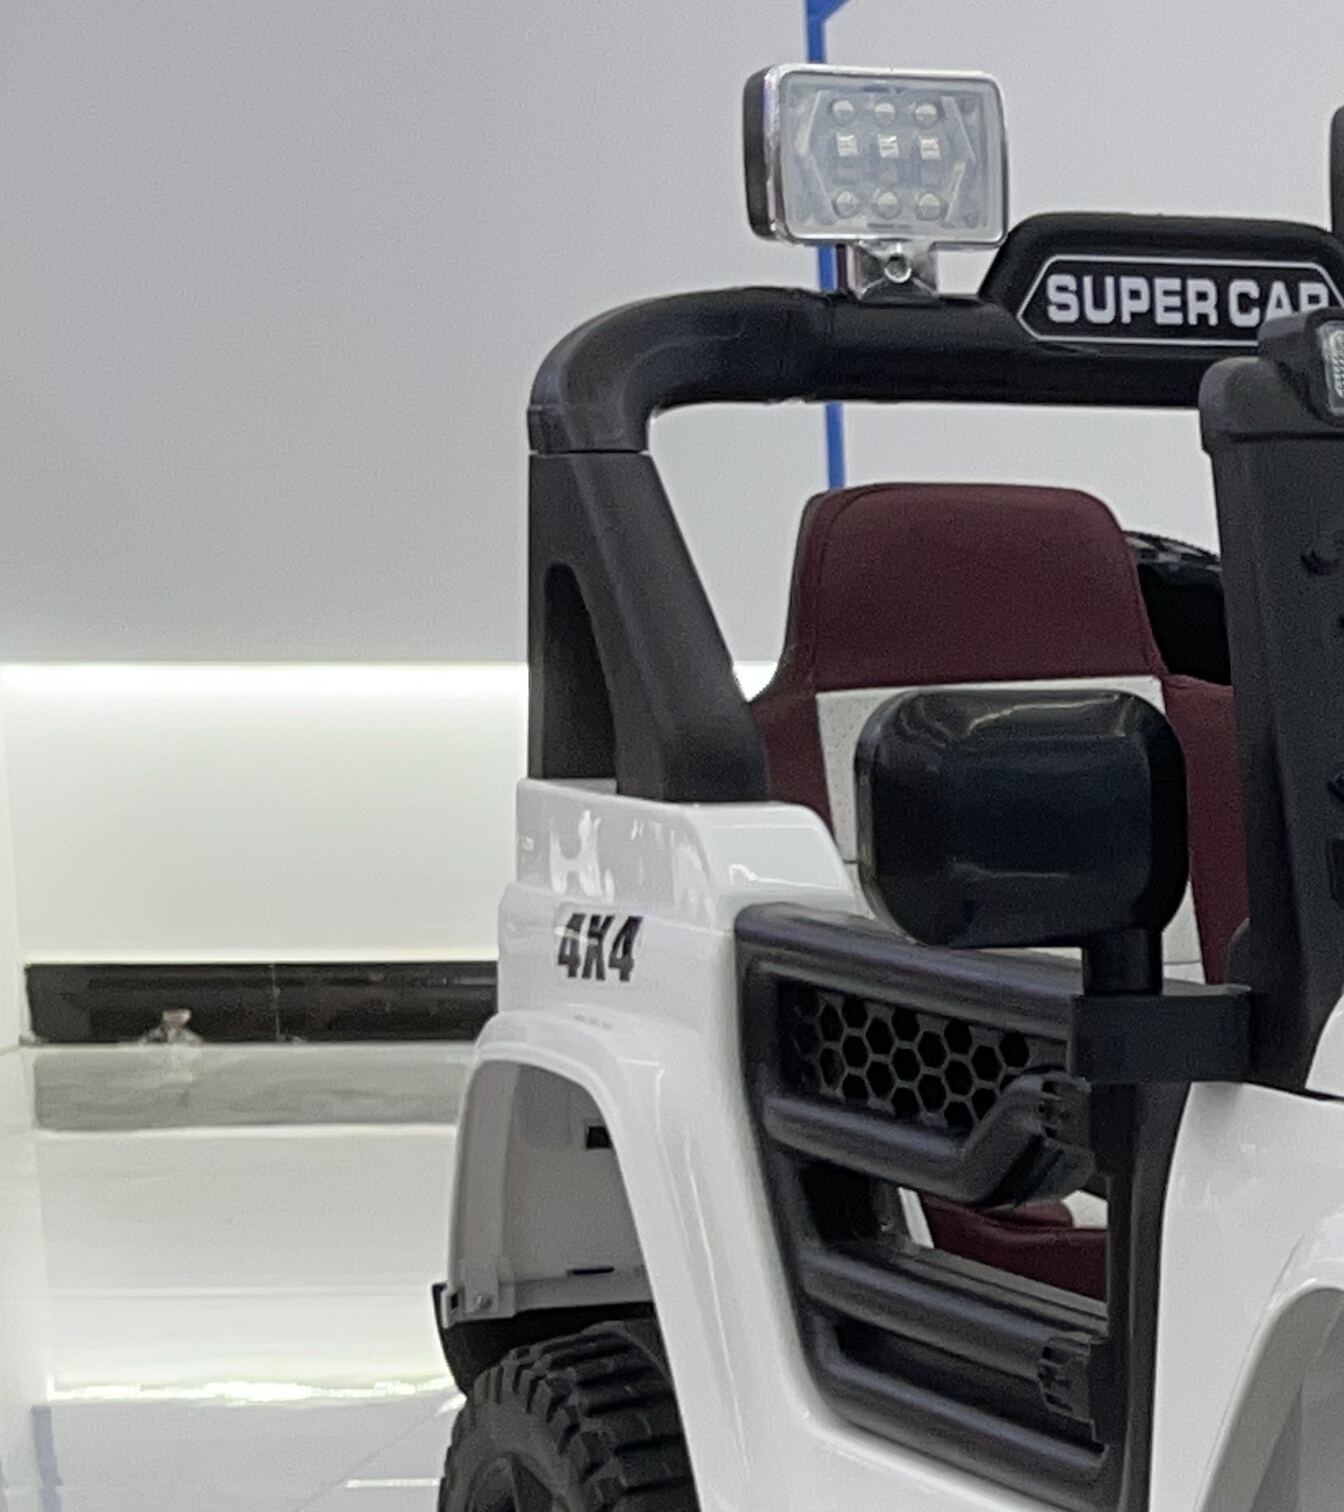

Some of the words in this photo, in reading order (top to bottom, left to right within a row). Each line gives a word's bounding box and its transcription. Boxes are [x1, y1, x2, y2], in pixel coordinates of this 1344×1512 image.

[1046, 273, 1219, 326] SUPER
[1227, 278, 1330, 327] CAR
[557, 912, 644, 982] 4X4
